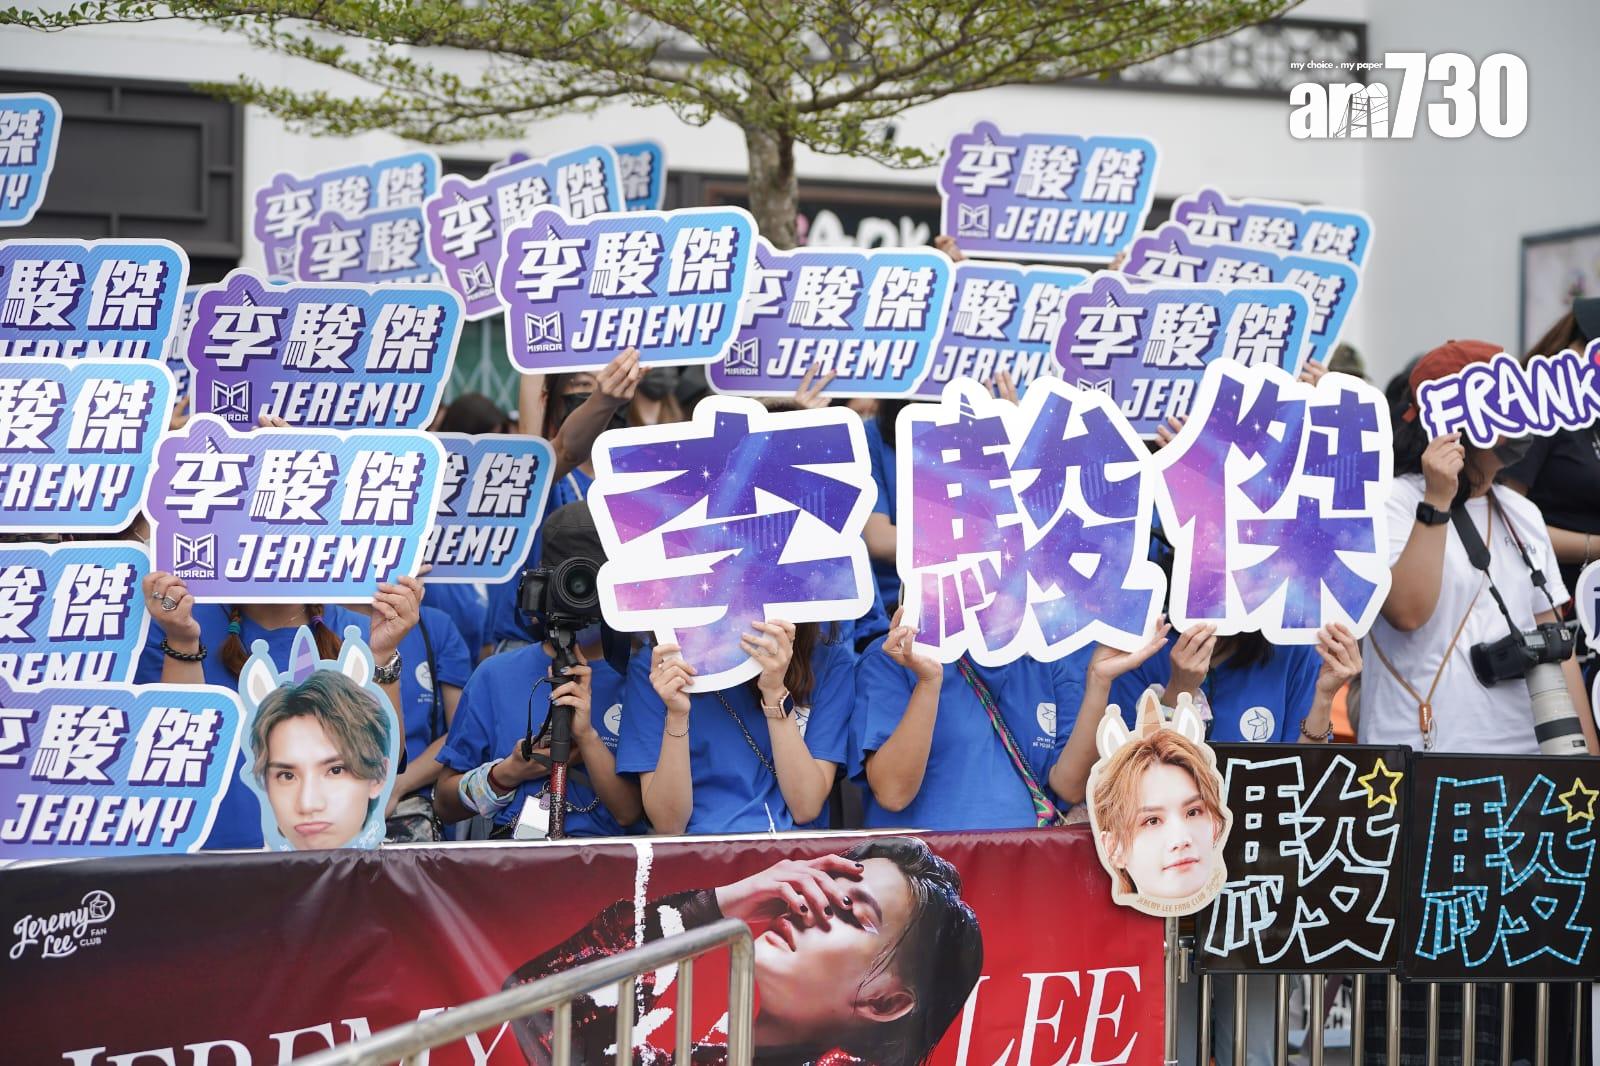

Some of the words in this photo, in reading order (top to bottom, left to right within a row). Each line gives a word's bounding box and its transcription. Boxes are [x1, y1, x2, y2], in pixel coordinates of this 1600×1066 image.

[953, 143, 1144, 202] 李駿傑
[264, 162, 425, 240] 李駿傑
[437, 156, 608, 259] 李駿傑
[995, 206, 1128, 246] JEREMY
[514, 226, 739, 302] 李駿傑
[203, 300, 442, 370] 李駿傑
[570, 302, 724, 351] JEREMY
[1069, 300, 1293, 368] 李駿傑
[766, 338, 918, 379] JEREMY
[258, 381, 422, 426] JEREMY
[164, 448, 419, 521] 李駿傑
[224, 534, 403, 579] JEREMY
[1, 793, 195, 844] JEREMY
[1204, 754, 1400, 964] 駿
[1415, 773, 1597, 968] 駿
[9, 906, 89, 960] Jeremy
[41, 934, 77, 959] Lee
[80, 937, 102, 947] CLUB
[91, 928, 107, 936] FAN
